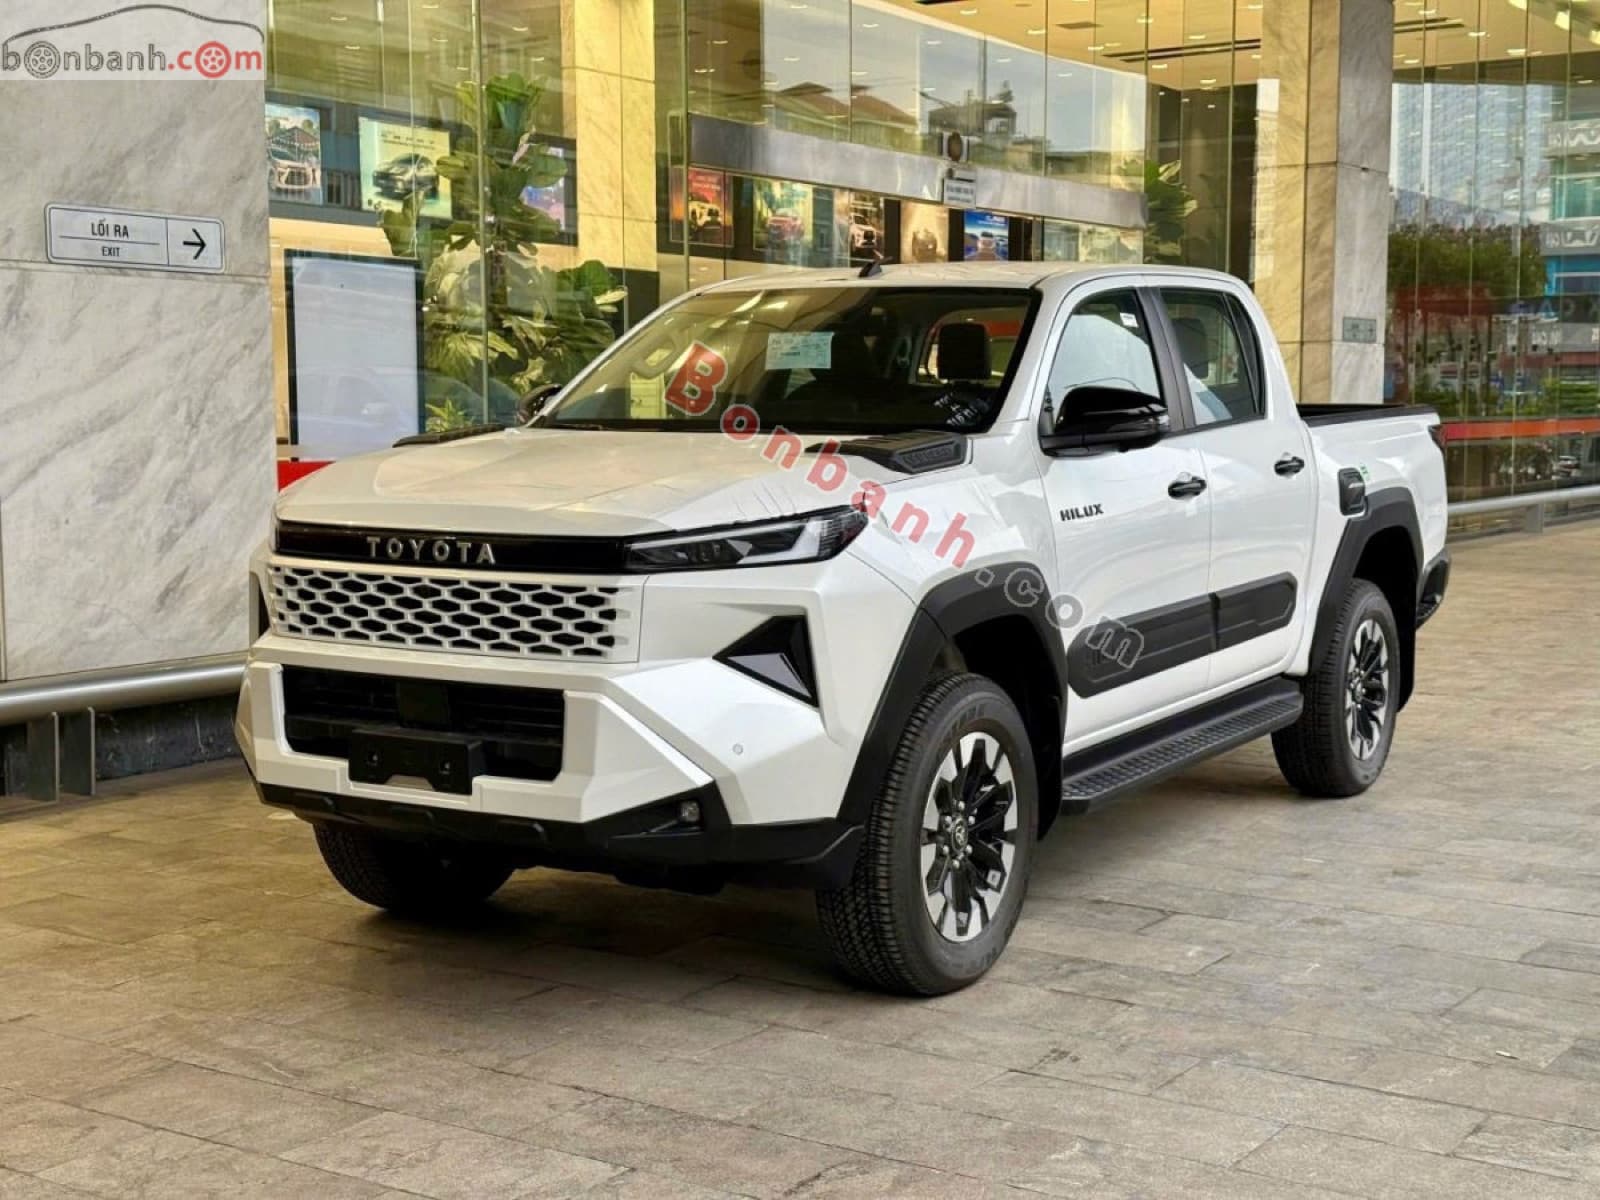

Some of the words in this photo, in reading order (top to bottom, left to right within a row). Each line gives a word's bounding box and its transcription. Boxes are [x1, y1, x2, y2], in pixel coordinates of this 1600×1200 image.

[91, 218, 109, 238] LỐI
[114, 224, 129, 239] RA
[102, 246, 120, 257] EXIT
[1060, 503, 1104, 521] HILUX
[366, 536, 496, 565] TOYOTA
